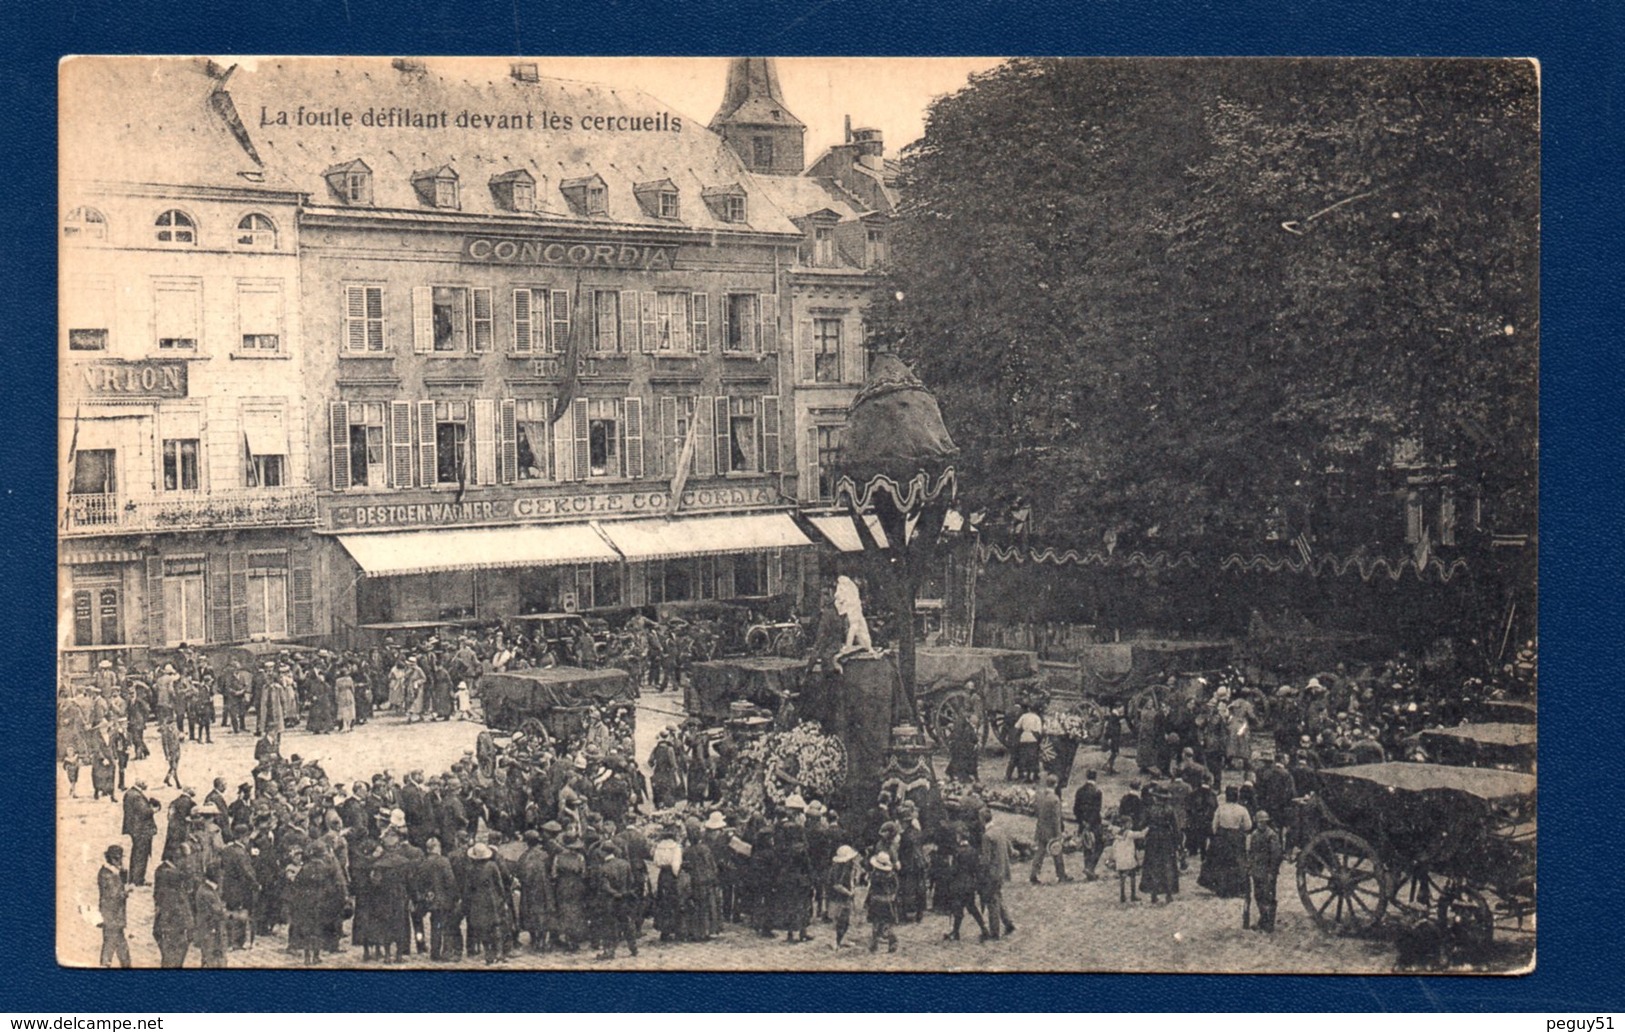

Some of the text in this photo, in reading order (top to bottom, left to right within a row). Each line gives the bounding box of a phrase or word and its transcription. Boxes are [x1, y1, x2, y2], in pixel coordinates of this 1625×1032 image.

[469, 239, 672, 266] CONCORDIA
[534, 359, 600, 376] HOEL
[517, 497, 625, 516] CERCLE
